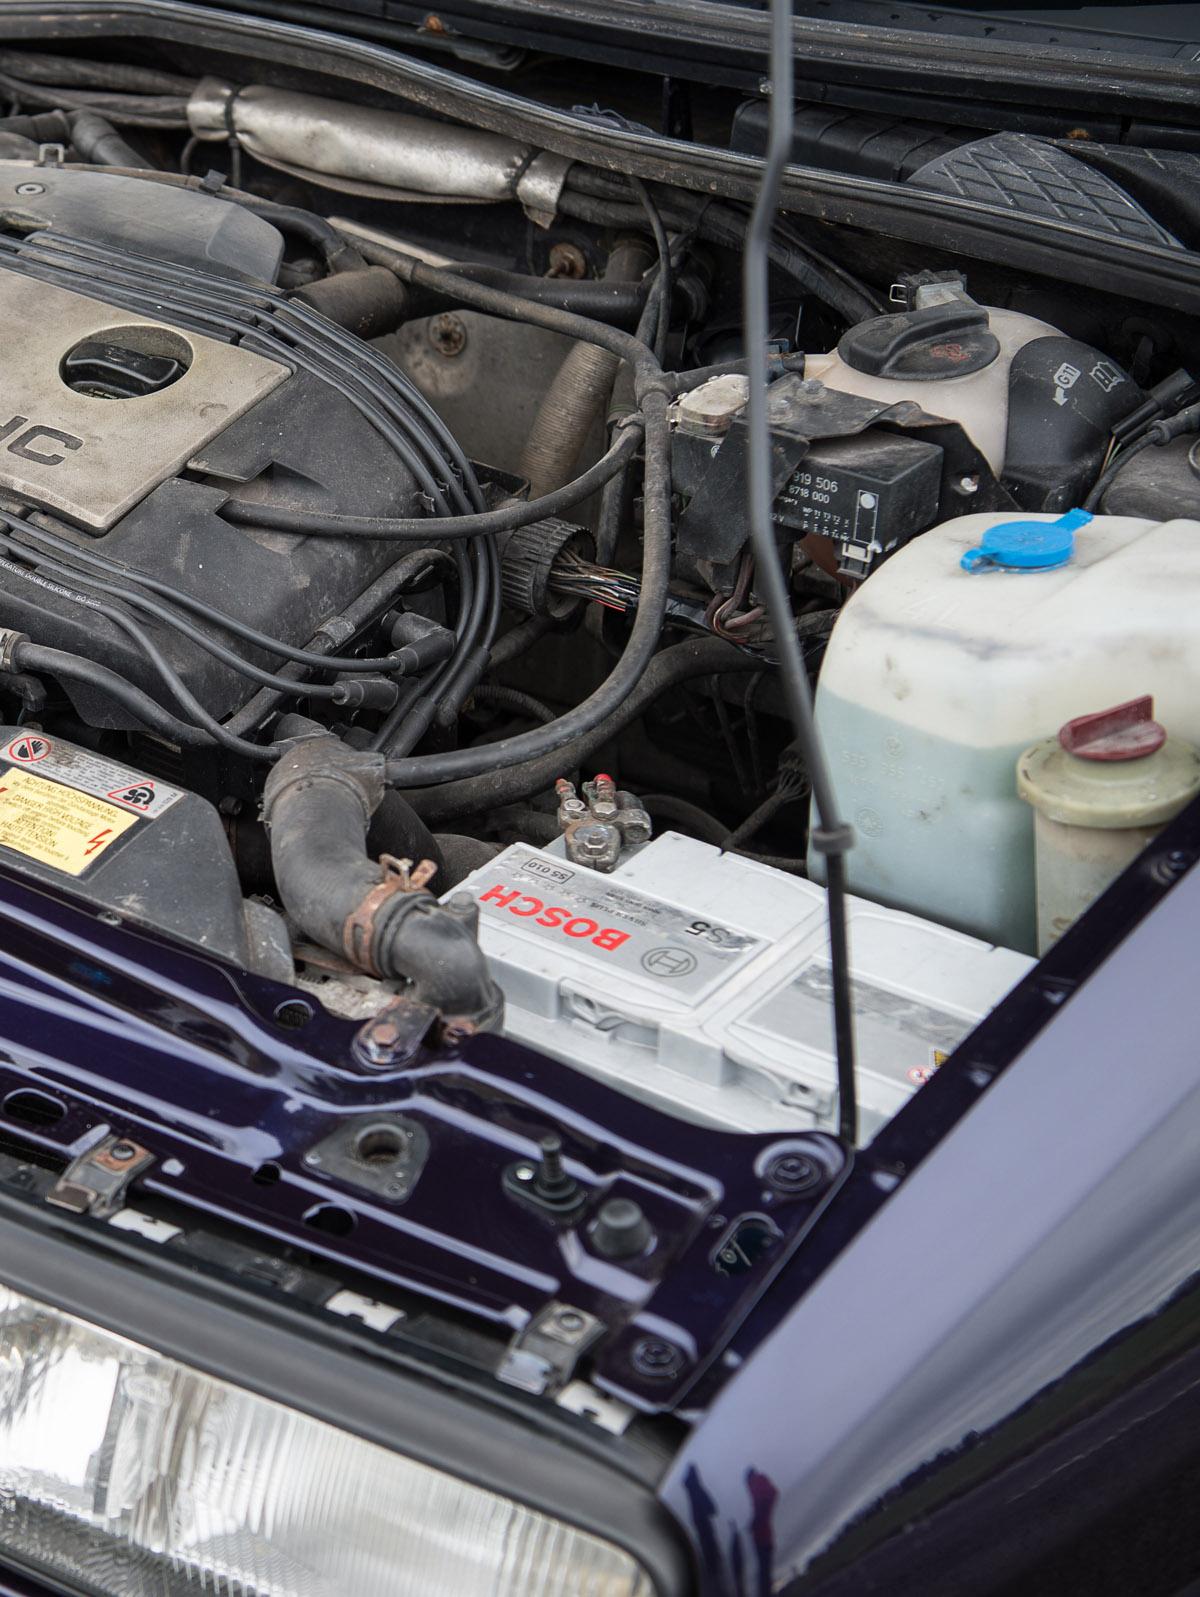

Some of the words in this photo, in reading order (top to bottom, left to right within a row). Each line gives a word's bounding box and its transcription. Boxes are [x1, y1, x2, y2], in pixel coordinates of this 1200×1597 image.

[1057, 365, 1078, 385] G11
[794, 471, 812, 485] 919
[815, 476, 839, 493] 506
[789, 485, 809, 498] 8718
[812, 490, 830, 504] 000
[25, 573, 47, 588] DOUBLE
[47, 582, 73, 598] SILICONE
[23, 777, 58, 794] ACHTUNG
[12, 794, 44, 810] DANGER
[43, 804, 62, 817] HIGH
[61, 811, 94, 830] VOLTAGE
[0, 820, 25, 834] HAUTE
[25, 829, 58, 848] TENSION
[527, 861, 550, 873] 010
[549, 869, 568, 881] S5
[479, 884, 632, 951] BOSCH
[685, 920, 731, 944] S5
